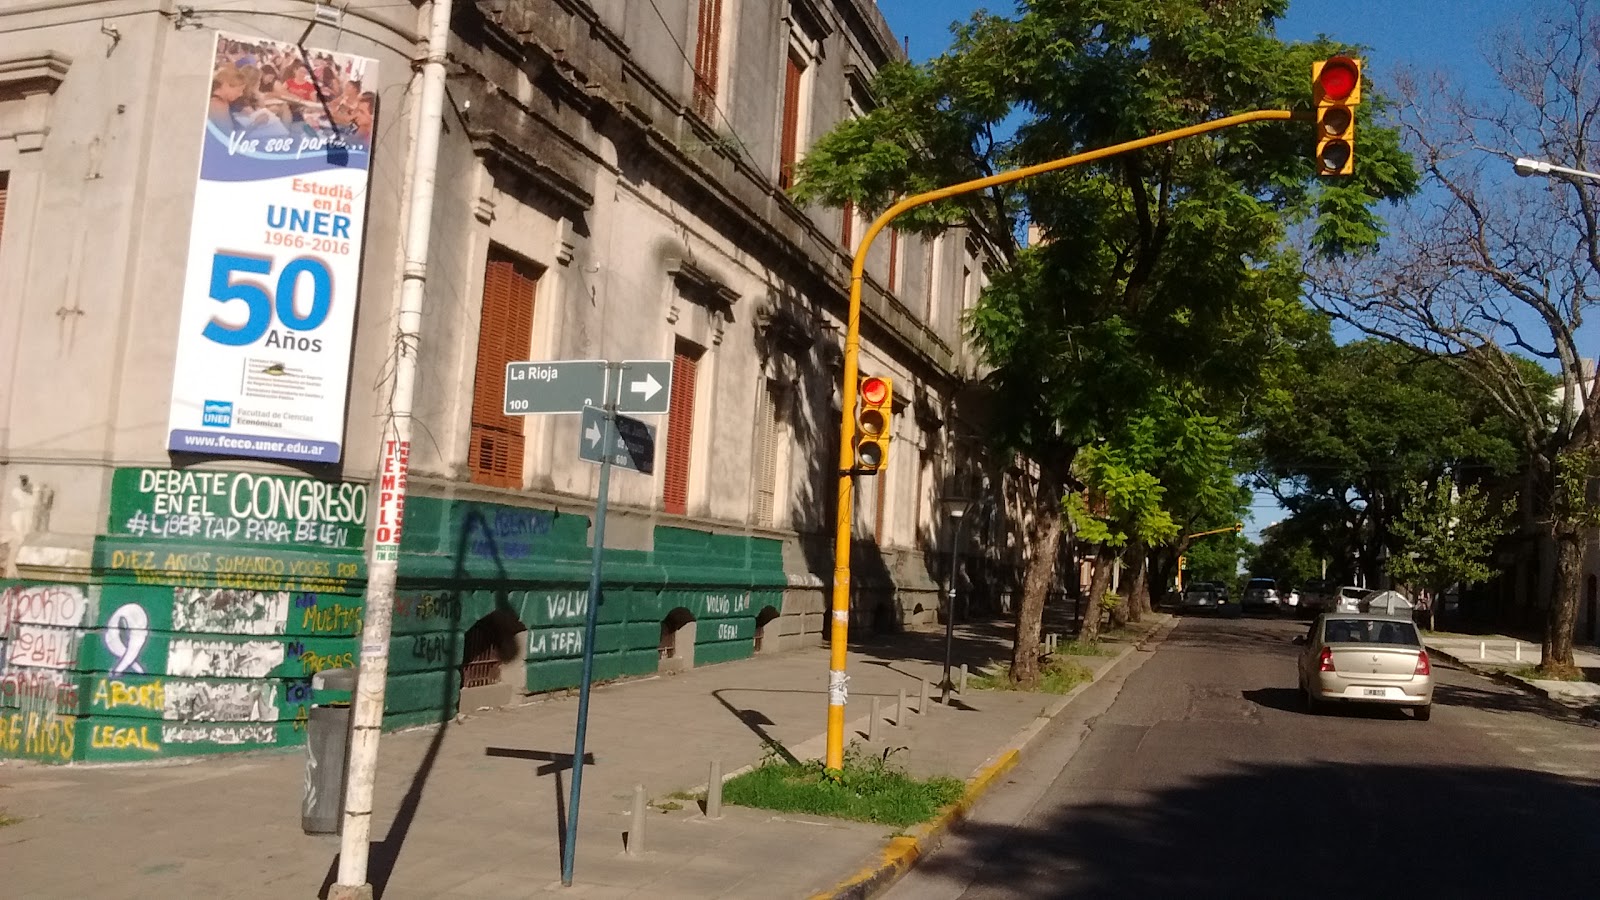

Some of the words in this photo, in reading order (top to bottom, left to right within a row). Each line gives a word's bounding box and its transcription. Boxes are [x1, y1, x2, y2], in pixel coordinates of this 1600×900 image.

[228, 131, 259, 155] Vos
[265, 137, 293, 152] sos
[292, 178, 353, 200] Estudiá
[313, 200, 331, 211] en
[336, 199, 351, 214] la
[267, 204, 350, 239] UNER
[264, 231, 350, 255] 1966-2016
[201, 248, 335, 347] 50
[265, 329, 322, 353] Años
[511, 367, 524, 380] La
[528, 367, 558, 382] Rioja
[238, 408, 271, 418] Facultad
[283, 412, 313, 422] Ciencias
[509, 400, 529, 410] 100
[204, 413, 230, 424] UNER
[237, 417, 282, 428] Económicas
[185, 435, 324, 455] www.fceco.uner.edu.ar
[140, 469, 228, 495] DEBATE
[376, 441, 397, 542] TEMPLO
[154, 493, 183, 514] EN
[187, 495, 214, 516] EL
[231, 472, 366, 524] CONGRESO
[246, 518, 292, 543] PARA
[338, 563, 358, 577] POR
[734, 594, 743, 612] LA
[530, 630, 546, 653] LA
[551, 630, 582, 654] JEFA
[91, 725, 160, 752] LEGAL
